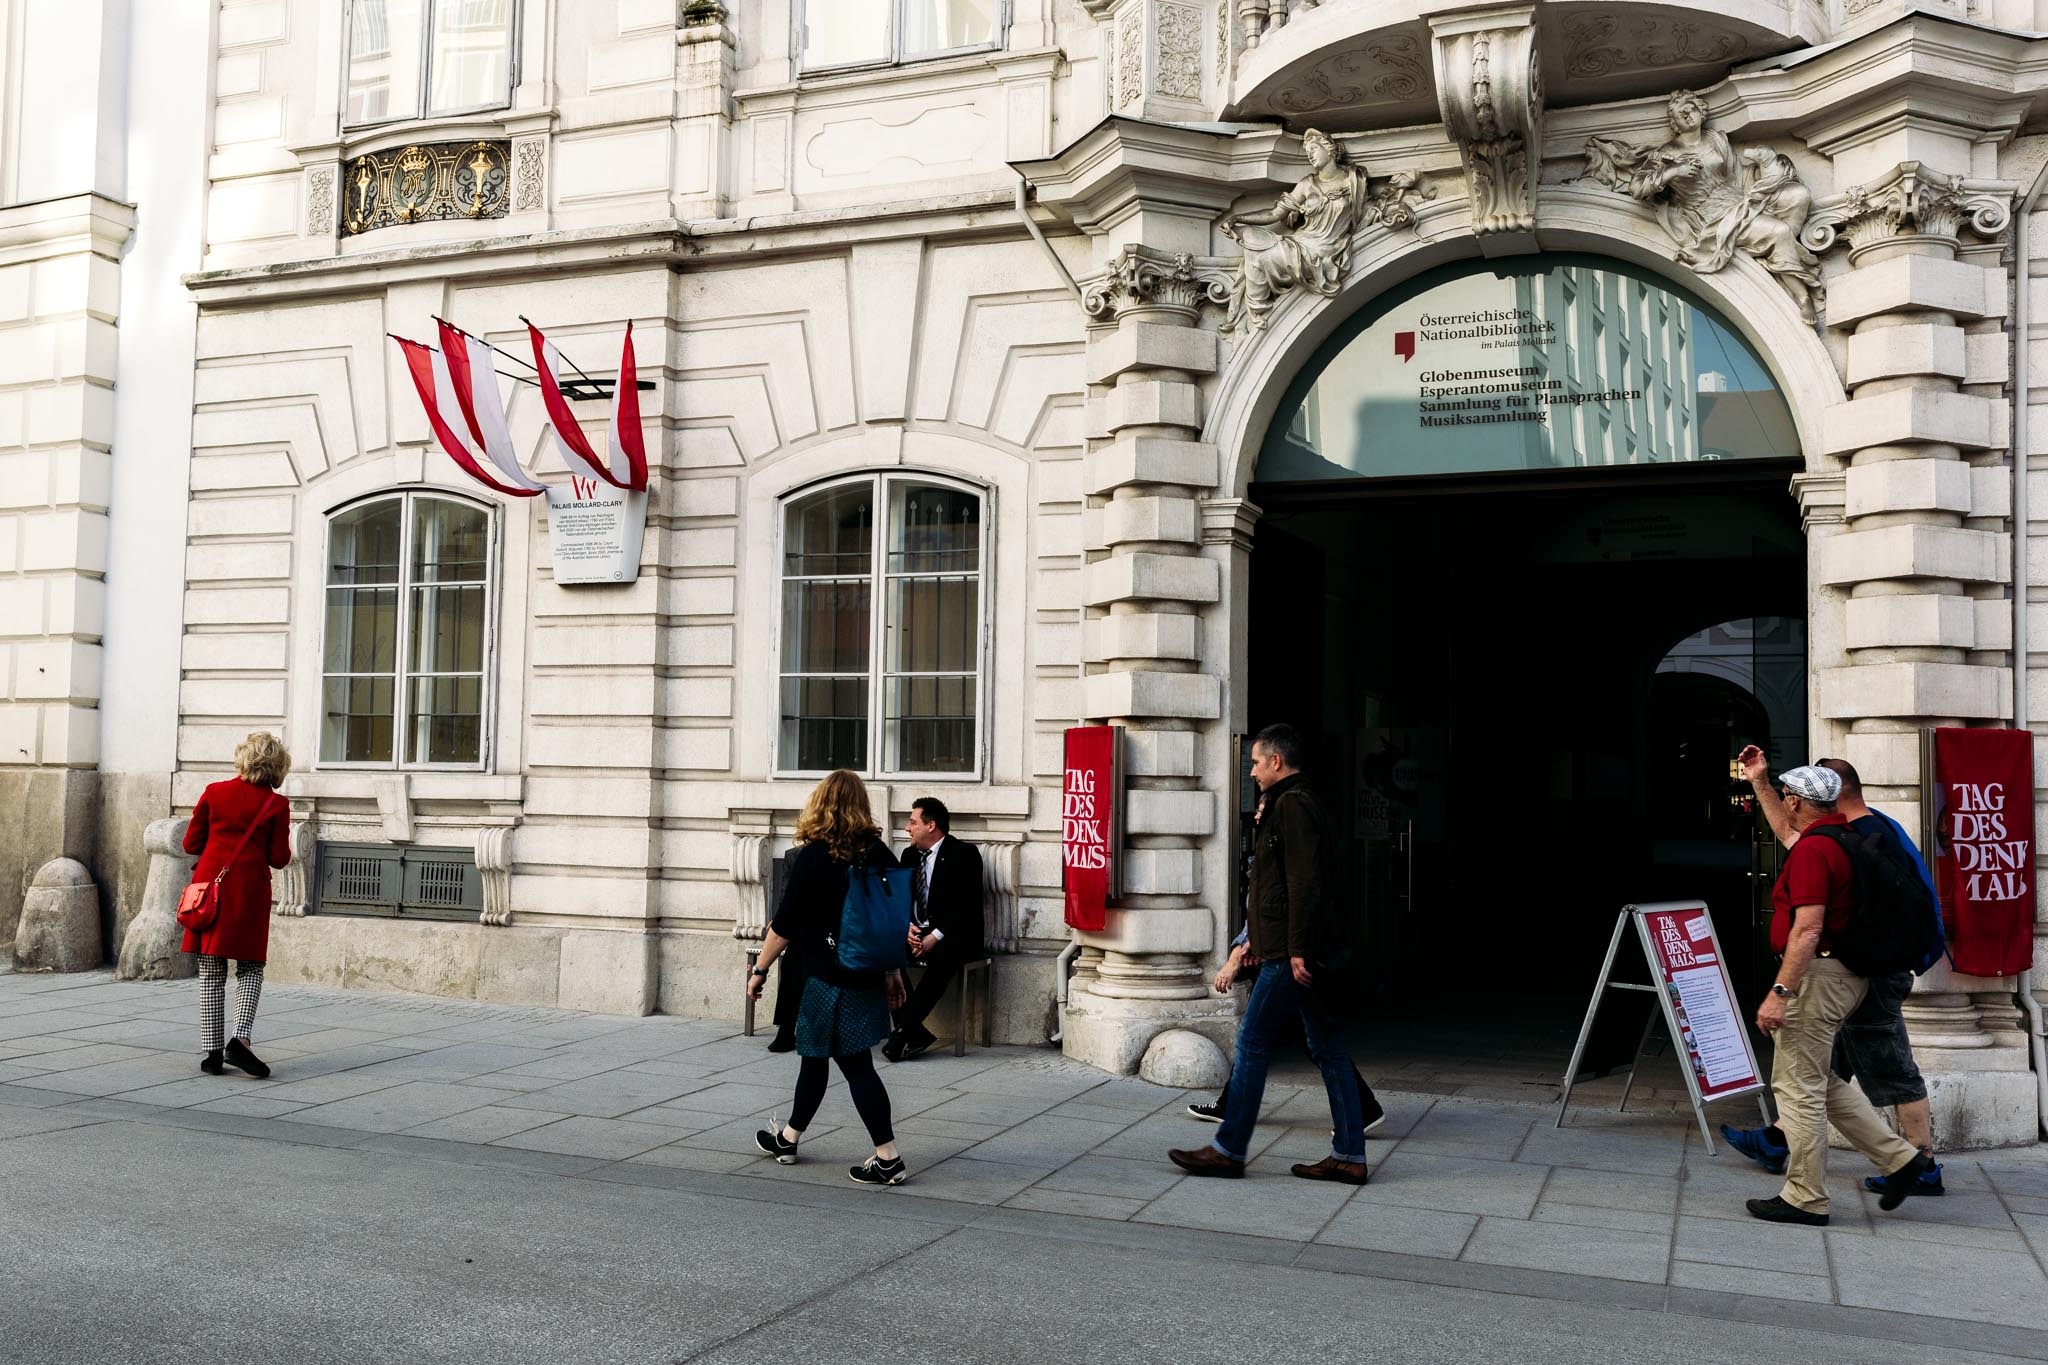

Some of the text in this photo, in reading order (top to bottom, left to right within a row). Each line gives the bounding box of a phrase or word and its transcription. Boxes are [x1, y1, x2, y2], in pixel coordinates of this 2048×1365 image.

[1420, 308, 1530, 327] Österreichische
[1420, 321, 1556, 341] Nationalbibliothek
[1481, 336, 1556, 349] im Palais Mollard
[1420, 366, 1540, 383] Globenmuseum
[1420, 379, 1563, 399] Esperantomuseum
[1420, 388, 1641, 413] Sammlung für Plansprachen
[1420, 410, 1547, 428] Musiksammlung
[573, 500, 623, 509] MOLLARD-CLARY
[1065, 769, 1095, 793] TAG
[1063, 794, 1095, 818] DES
[1952, 783, 2005, 811] TAG
[1062, 818, 1104, 844] DENK
[1951, 813, 2007, 841] DES
[1657, 915, 1676, 930] TAG
[1660, 928, 1681, 942] DES
[1664, 940, 1692, 955] DENK
[1668, 952, 1696, 968] MALS
